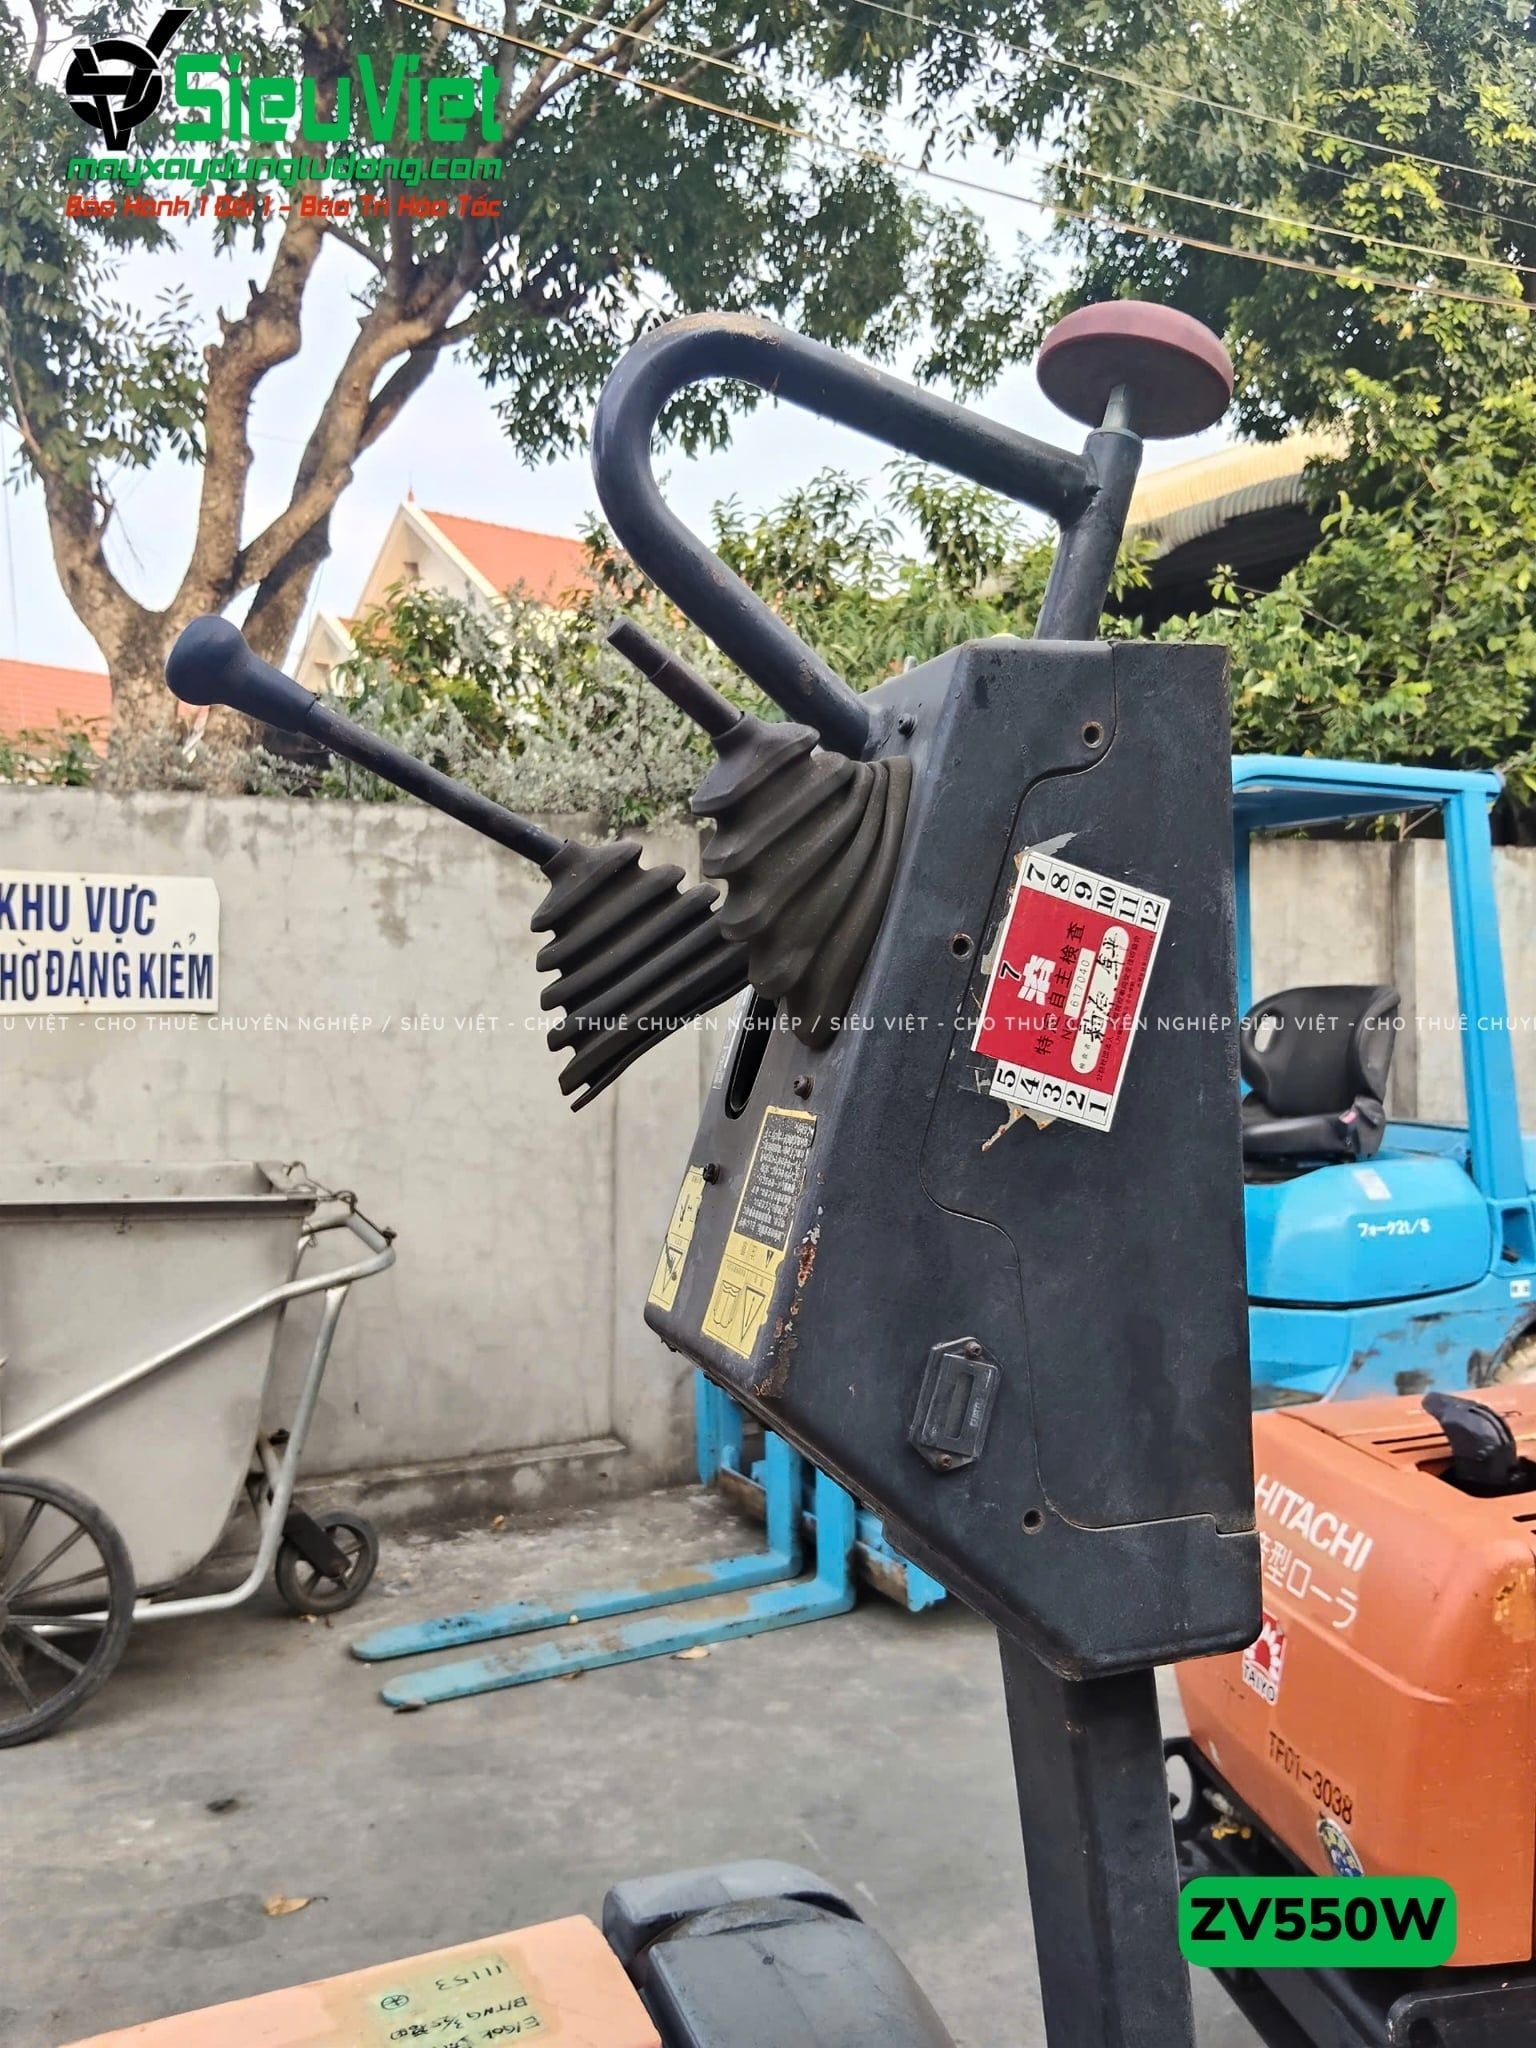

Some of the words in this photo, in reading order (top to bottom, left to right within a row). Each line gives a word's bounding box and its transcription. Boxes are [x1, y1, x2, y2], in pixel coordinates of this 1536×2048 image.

[1026, 862, 1046, 882] 7
[1050, 871, 1070, 893] 8
[1073, 880, 1093, 901] 9
[1096, 885, 1118, 912] 10
[0, 883, 70, 932] KHU
[85, 883, 157, 944] VỰC
[1118, 896, 1140, 919] 11
[1140, 900, 1162, 928] 12
[139, 932, 213, 999] KIỂM
[1000, 958, 1022, 981] 7
[1070, 958, 1090, 1008] 617040
[998, 1066, 1017, 1089] 5
[1020, 1074, 1041, 1095] 4
[1042, 1080, 1062, 1103] 3
[1065, 1088, 1086, 1110] 2
[1089, 1102, 1108, 1116] 1
[1254, 1472, 1374, 1573] HITACHI
[1268, 1730, 1354, 1826] TF01-3038
